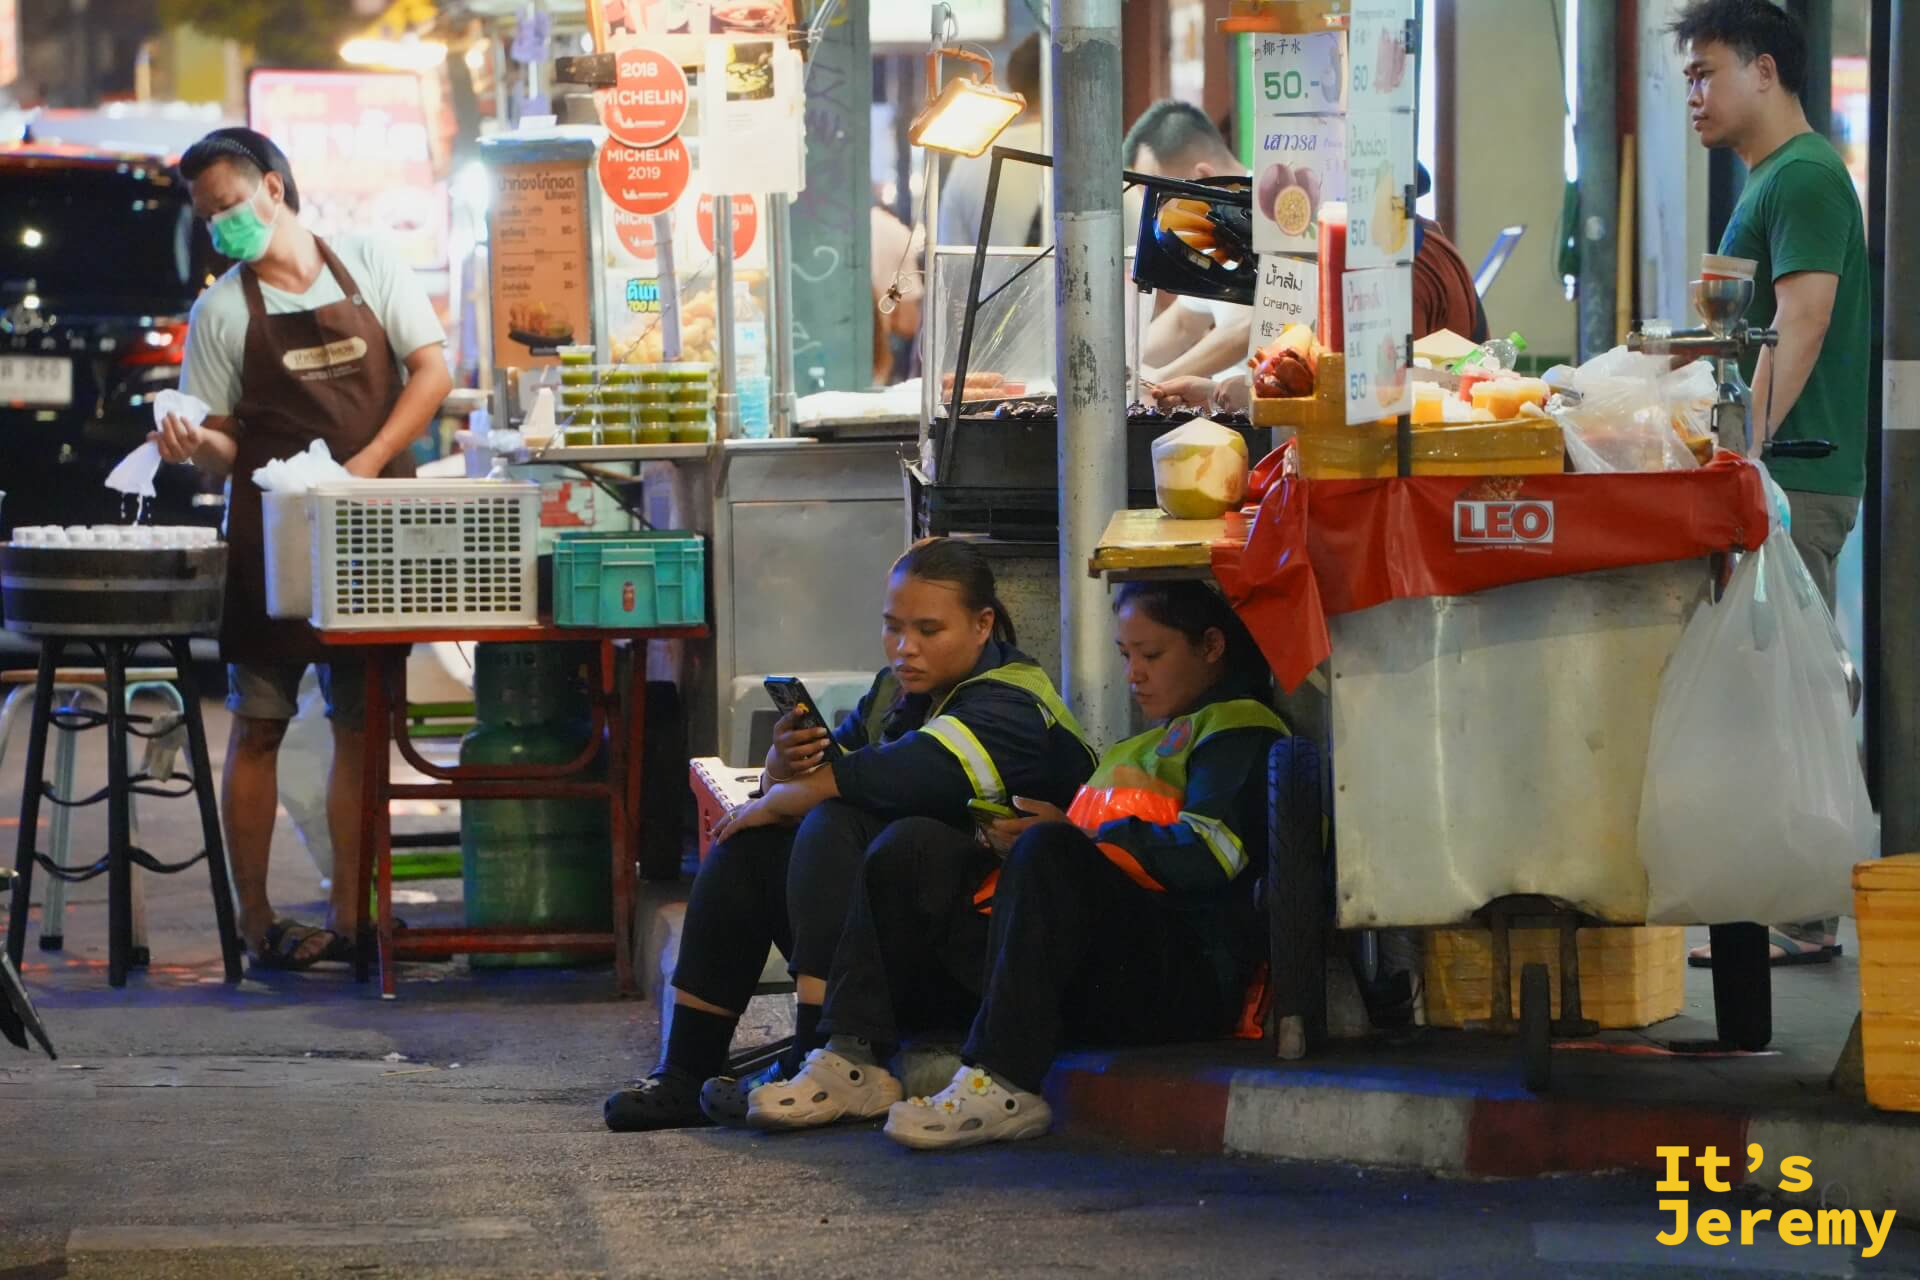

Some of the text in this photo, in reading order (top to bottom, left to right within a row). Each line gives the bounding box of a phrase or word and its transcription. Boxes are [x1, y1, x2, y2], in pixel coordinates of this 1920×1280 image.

[1263, 38, 1303, 57] 椰子水
[621, 62, 658, 78] 2018
[1353, 64, 1369, 92] 60
[1263, 70, 1321, 101] 50.-
[594, 89, 684, 106] MICHELIN
[1263, 134, 1319, 152] เสาวรส
[607, 149, 681, 162] MICHELIN
[627, 166, 661, 180] 2019
[1351, 218, 1367, 247] 50
[1265, 263, 1303, 291] น้ำส้ม
[1263, 295, 1303, 316] Orange
[1350, 372, 1368, 401] 50
[1458, 502, 1553, 542] LEO
